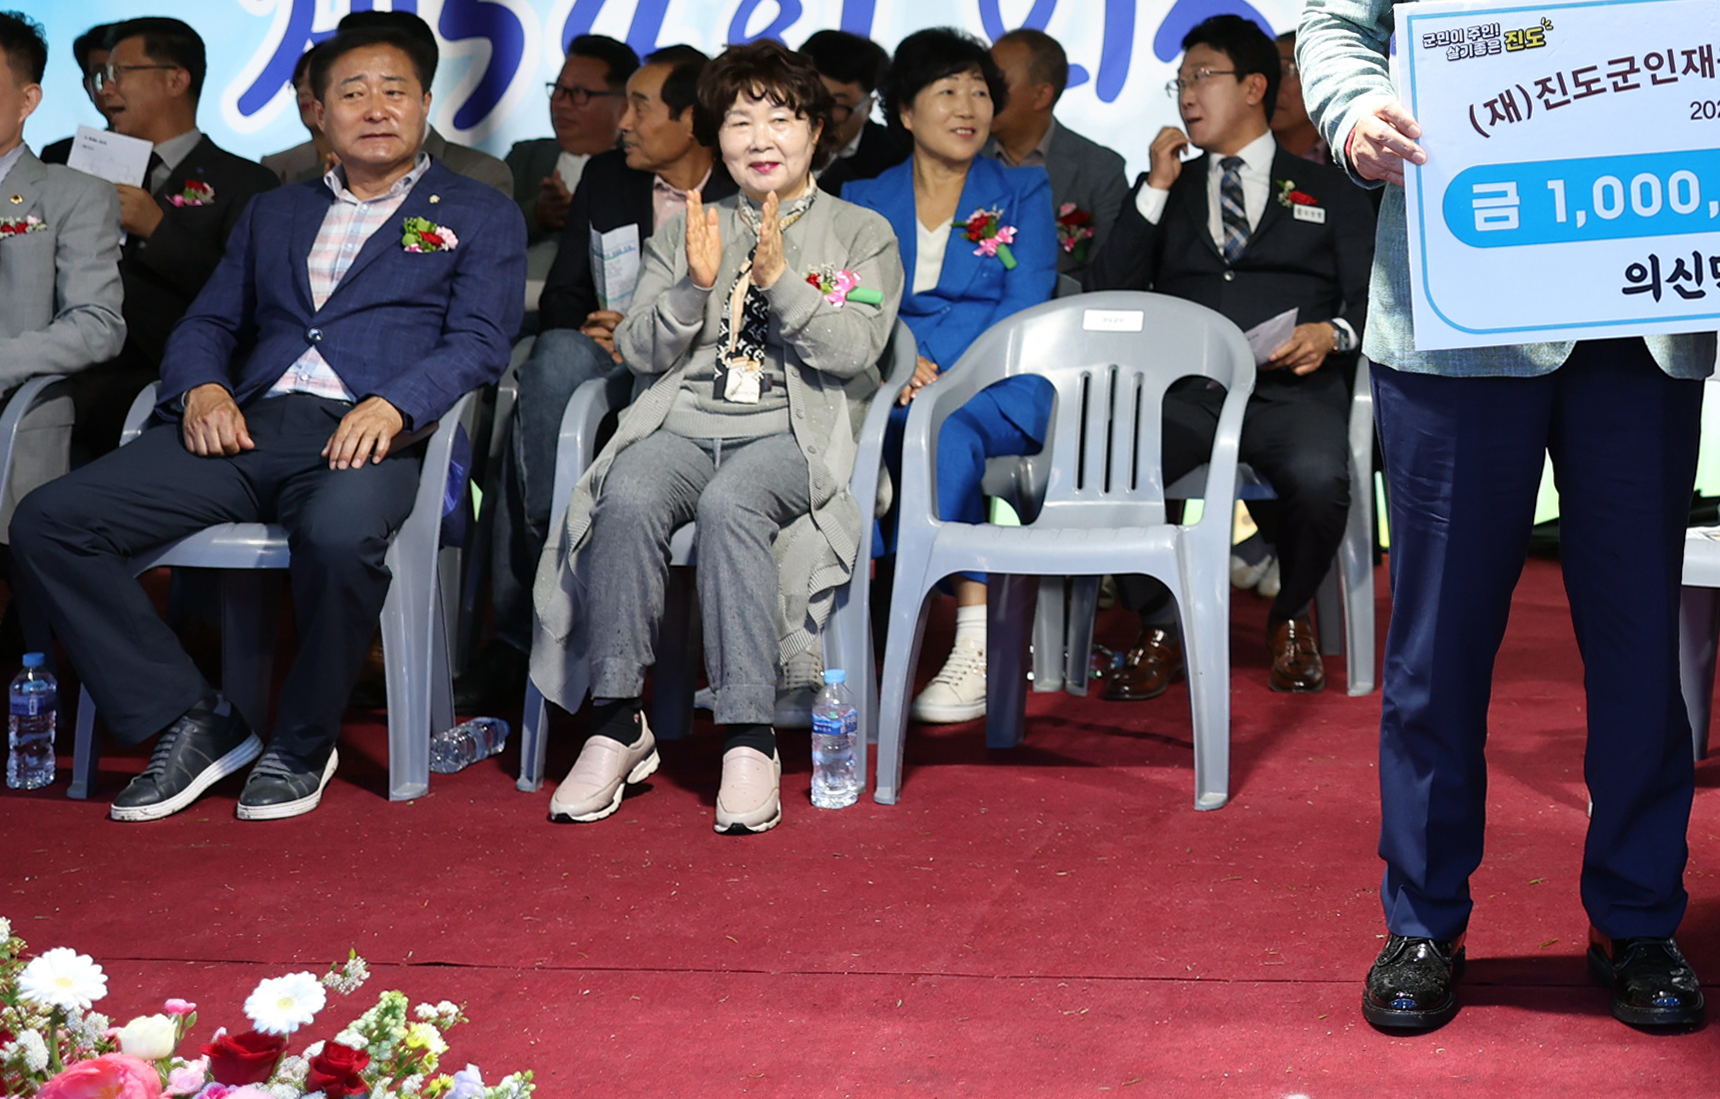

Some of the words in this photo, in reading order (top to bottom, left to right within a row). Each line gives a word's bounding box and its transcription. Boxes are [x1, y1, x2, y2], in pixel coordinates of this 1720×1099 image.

[1422, 27, 1465, 49] 군민이
[1466, 22, 1501, 42] 주인!
[1446, 38, 1502, 61] 살기좋은
[1503, 25, 1547, 52] 진도
[1471, 180, 1521, 232] 금
